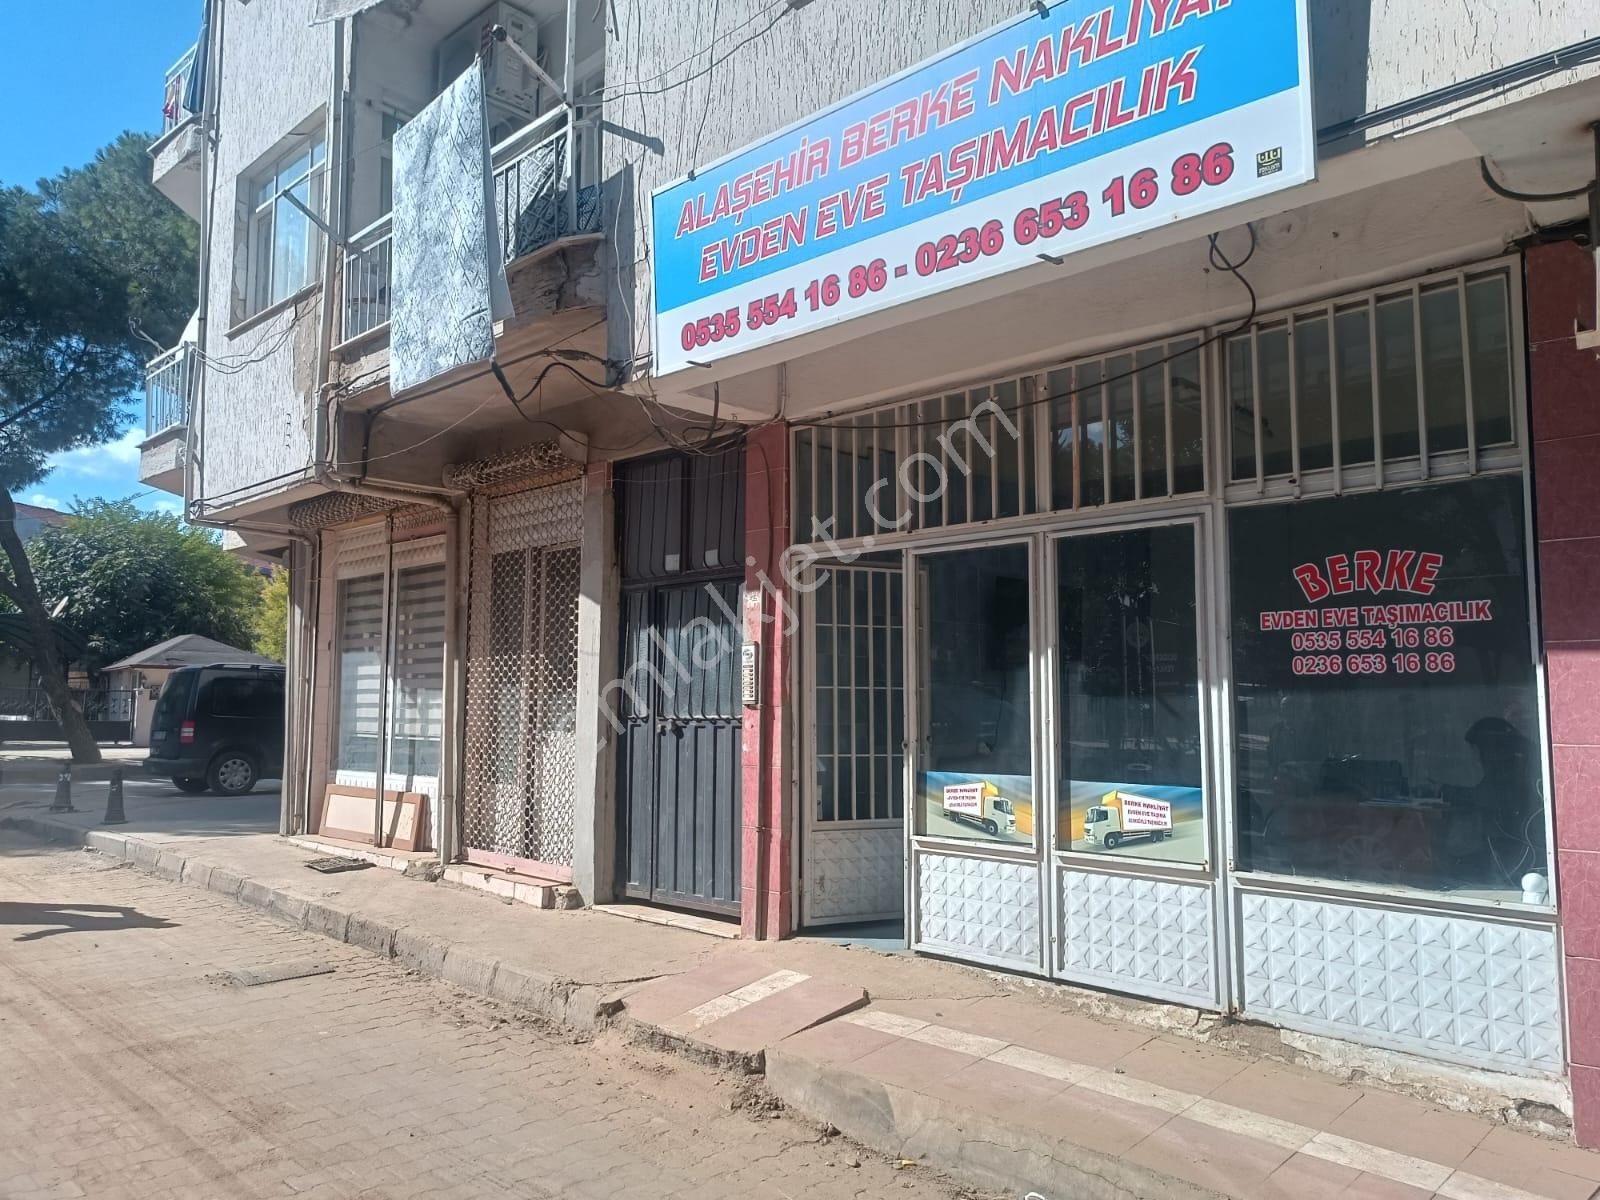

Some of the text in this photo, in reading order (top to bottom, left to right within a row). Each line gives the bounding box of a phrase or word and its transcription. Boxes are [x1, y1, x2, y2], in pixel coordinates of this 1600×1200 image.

[676, 137, 830, 239] ALAŞEHİR
[838, 68, 980, 170] BERKE
[698, 44, 1205, 283] EVDEN EVE TAŞIMACILIK
[681, 307, 740, 351] 0535
[747, 288, 797, 330] 554
[805, 274, 840, 311] 16
[848, 258, 887, 298] 86
[915, 219, 1004, 276] 0236
[1013, 190, 1090, 245] 653
[1102, 167, 1158, 217] 16
[1171, 142, 1234, 196] 86
[1293, 549, 1443, 603] BERKE
[1260, 600, 1492, 630] EVDEN EVE TAŞIMACILIK
[1291, 626, 1454, 651] 0535 554 16 86
[1292, 652, 1455, 675] 0236 653 16 86
